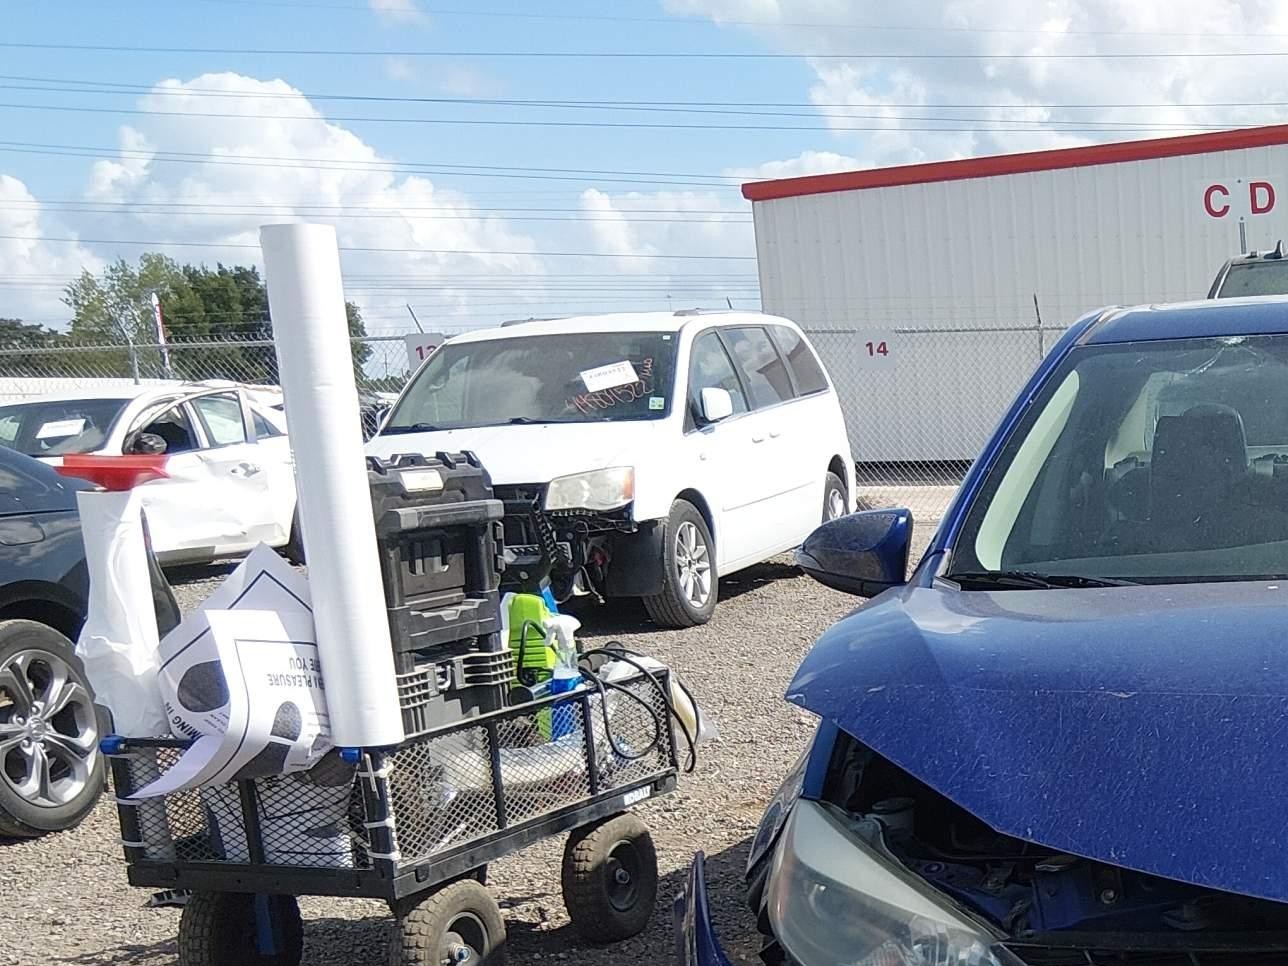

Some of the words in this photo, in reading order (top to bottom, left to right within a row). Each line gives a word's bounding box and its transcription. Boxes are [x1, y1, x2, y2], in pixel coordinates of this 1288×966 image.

[1204, 184, 1230, 217] C
[1249, 181, 1275, 214] D
[865, 341, 889, 356] 14
[289, 657, 308, 671] YOU
[266, 673, 312, 688] PLEASURE
[171, 715, 204, 741] MING
